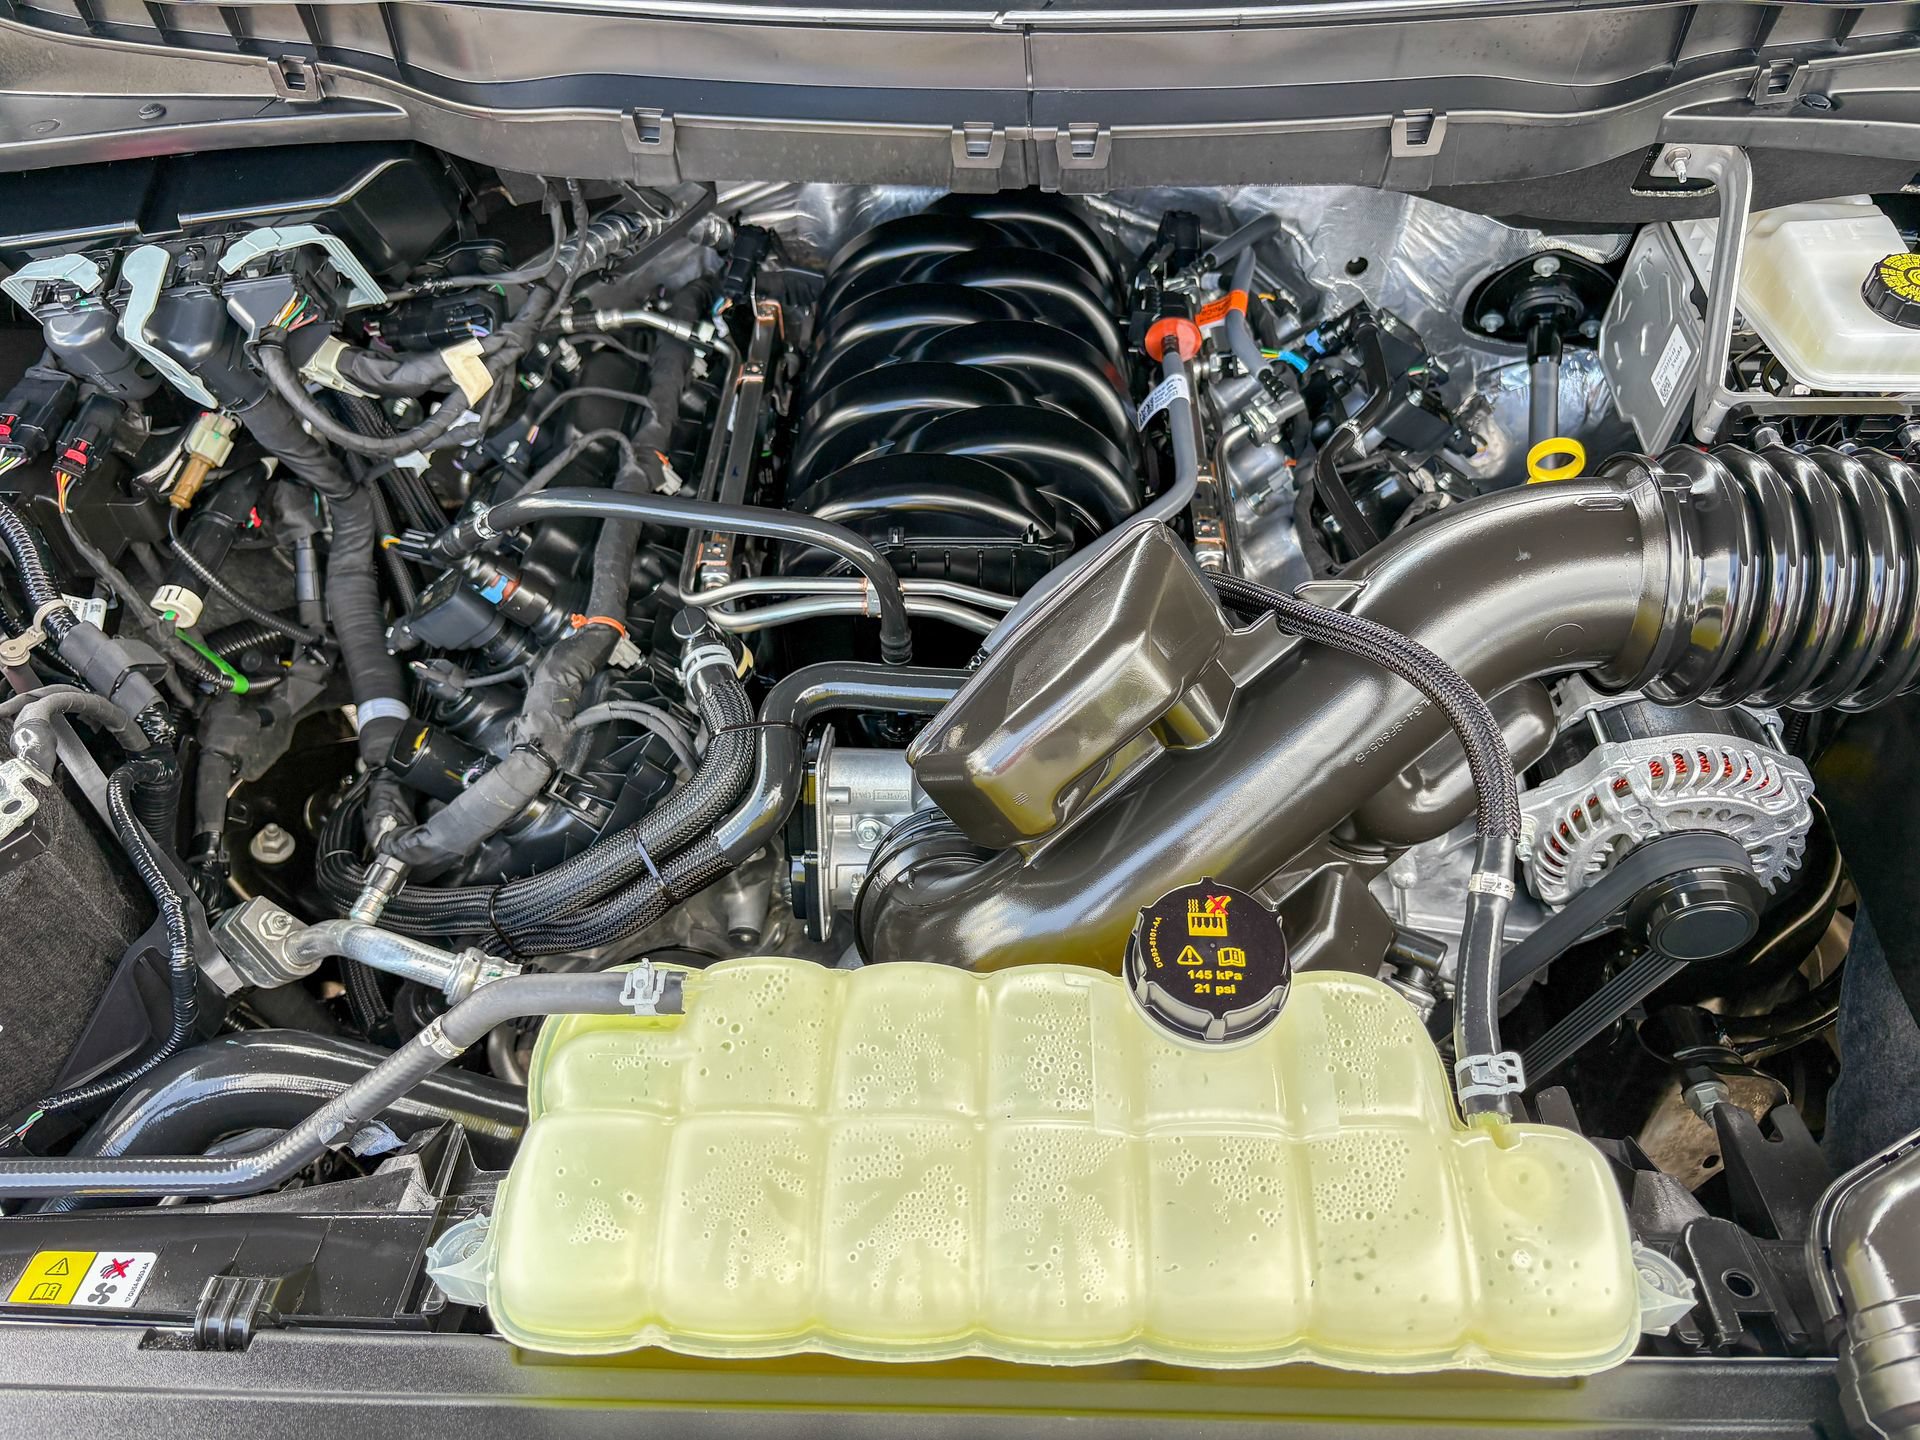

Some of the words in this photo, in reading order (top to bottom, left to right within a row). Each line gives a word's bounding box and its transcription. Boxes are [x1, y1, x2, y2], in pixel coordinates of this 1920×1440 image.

[1187, 969, 1213, 980] 145
[1216, 970, 1243, 981] kPa
[1194, 983, 1210, 993] 21
[1215, 984, 1236, 996] psi
